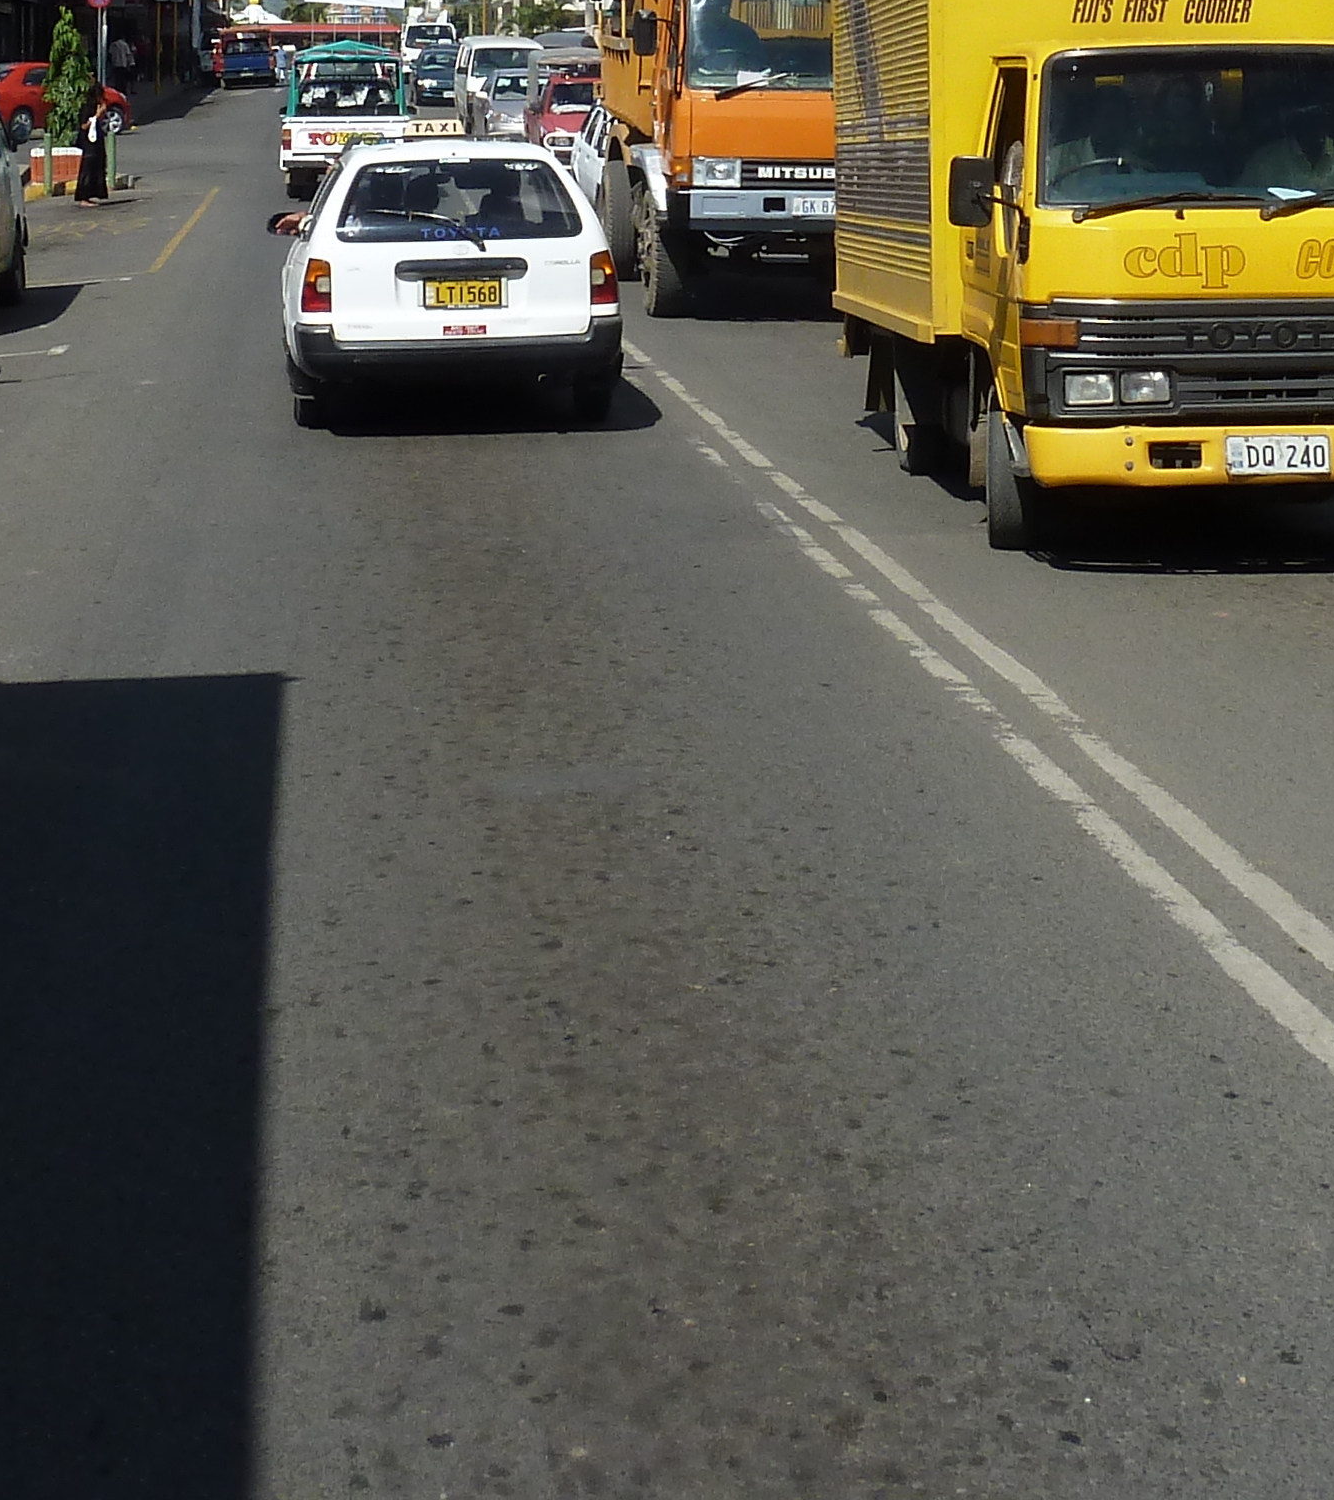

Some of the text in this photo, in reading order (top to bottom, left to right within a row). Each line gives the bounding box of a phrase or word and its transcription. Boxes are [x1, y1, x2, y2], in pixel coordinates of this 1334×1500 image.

[411, 123, 458, 134] TAXI
[801, 200, 817, 214] GK
[1123, 232, 1246, 289] cdp
[435, 285, 498, 304] LT1568
[1246, 442, 1326, 469] DQ 240
